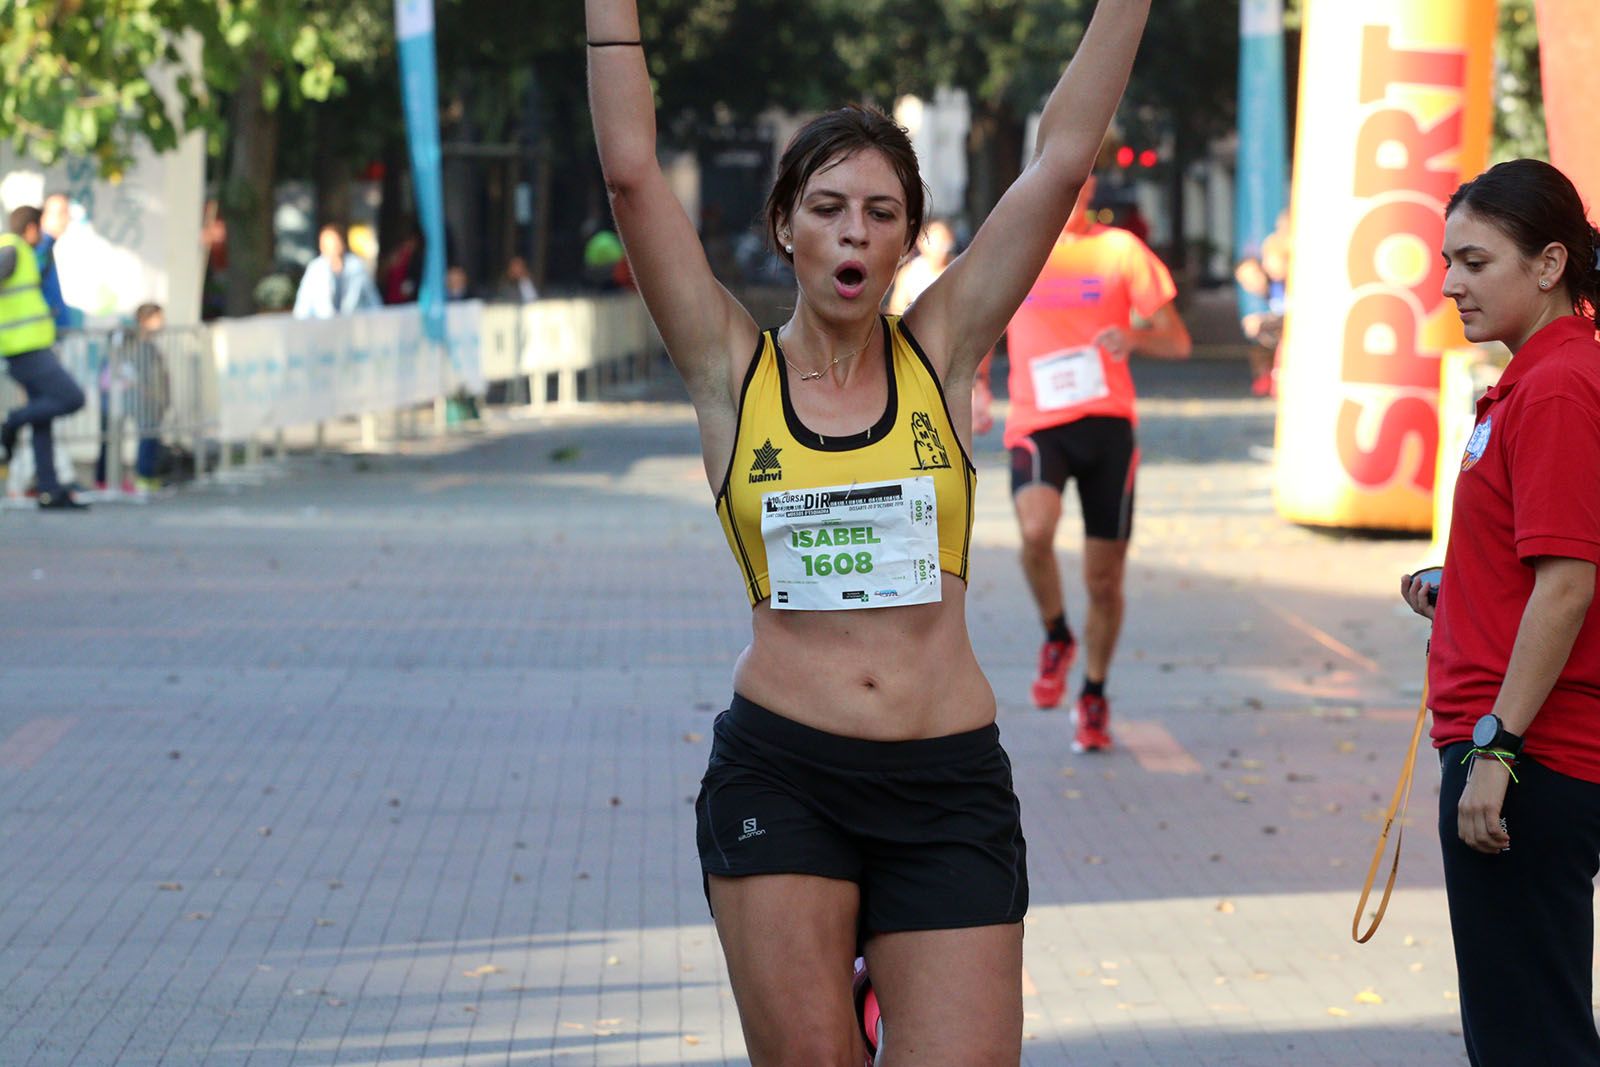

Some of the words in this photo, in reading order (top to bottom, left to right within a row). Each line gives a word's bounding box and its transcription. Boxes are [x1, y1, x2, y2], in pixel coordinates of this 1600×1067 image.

[1336, 24, 1468, 495] SPORT
[748, 470, 782, 484] luanvi
[781, 494, 804, 504] CURSA
[914, 499, 923, 522] 1608
[791, 526, 881, 548] ISABEL
[801, 551, 874, 577] 1608
[918, 558, 927, 581] 1608
